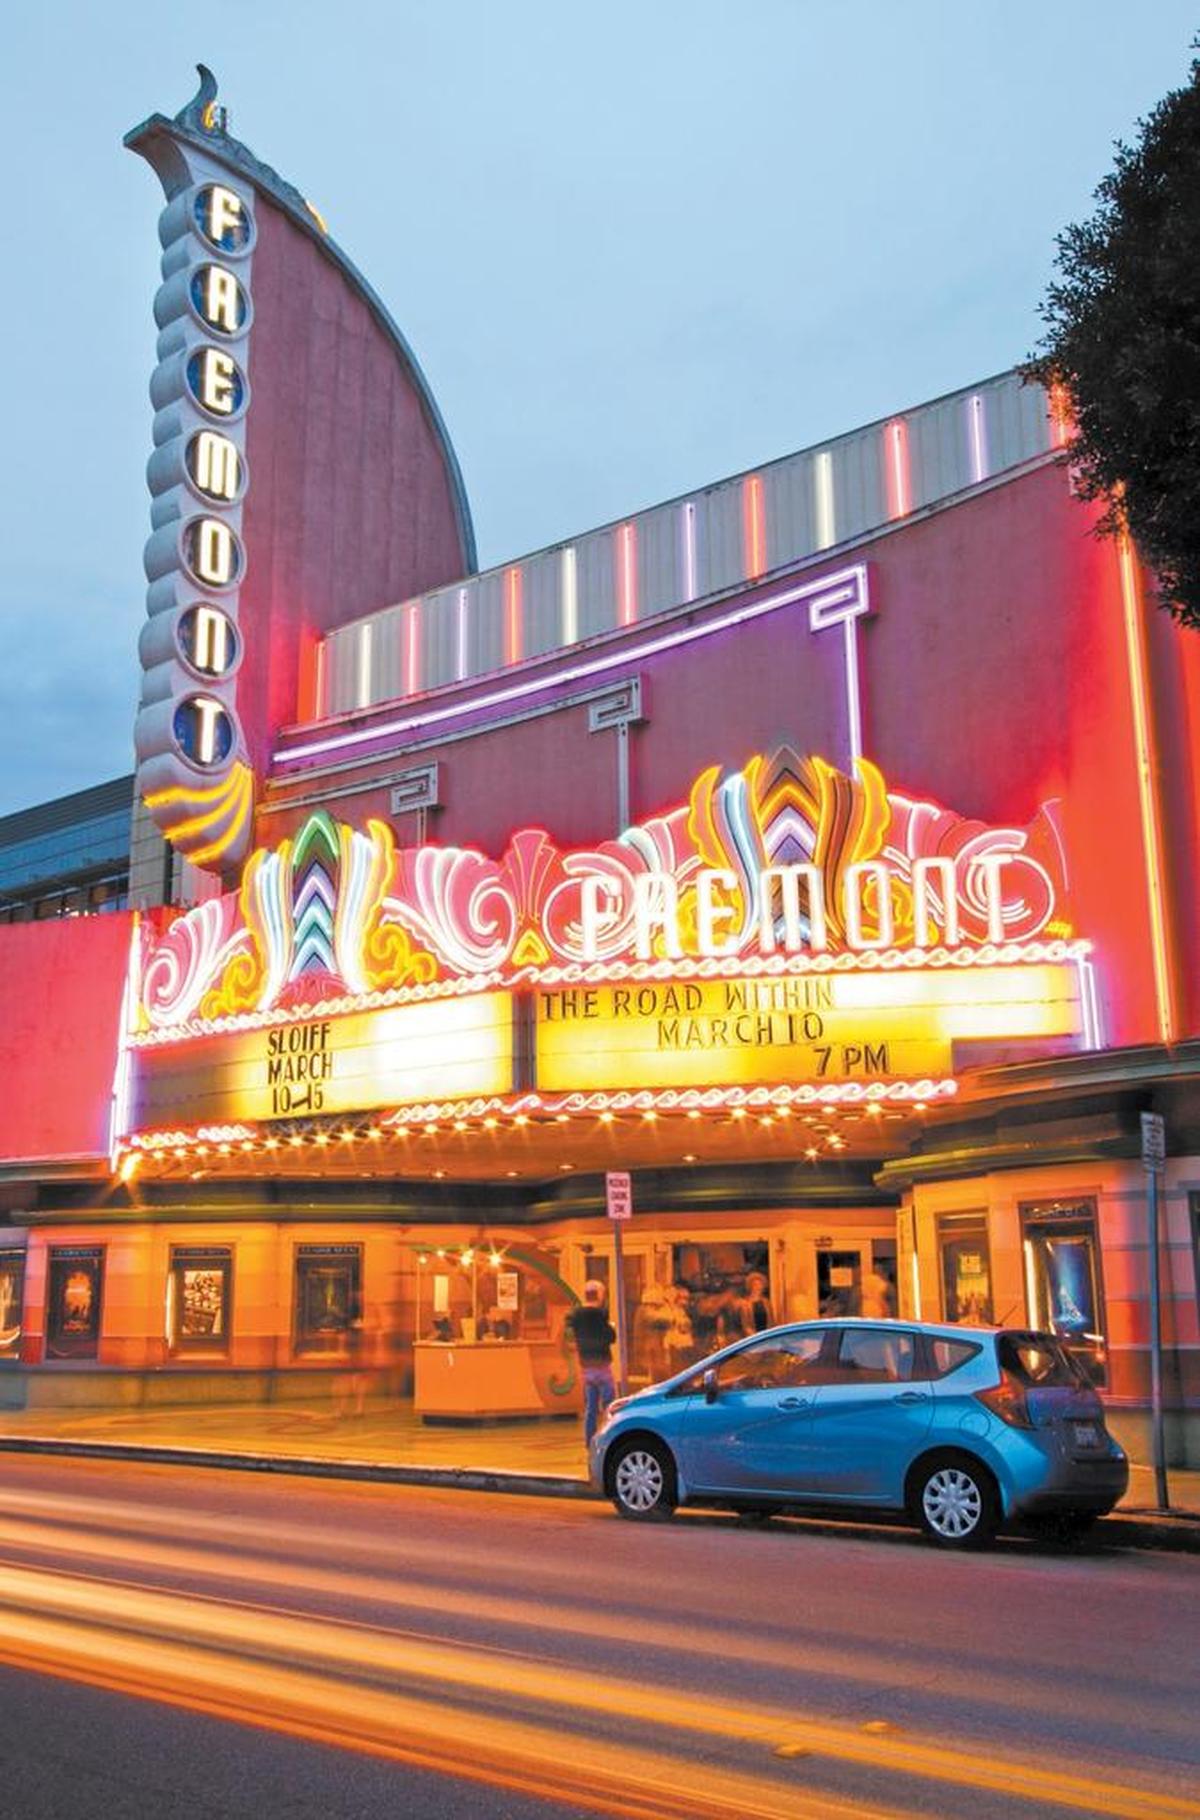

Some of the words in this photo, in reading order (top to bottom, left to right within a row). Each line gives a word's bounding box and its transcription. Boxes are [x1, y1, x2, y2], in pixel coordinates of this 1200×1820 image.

[541, 989, 599, 1020] THE
[614, 984, 703, 1017] ROAD
[725, 979, 832, 1010] WITHIN
[267, 1022, 331, 1056] SLOIFF
[657, 1015, 773, 1050] MARCH
[787, 1012, 824, 1044] 10
[267, 1052, 333, 1085] MARCH
[813, 1046, 832, 1076] 7
[844, 1043, 890, 1075] PM
